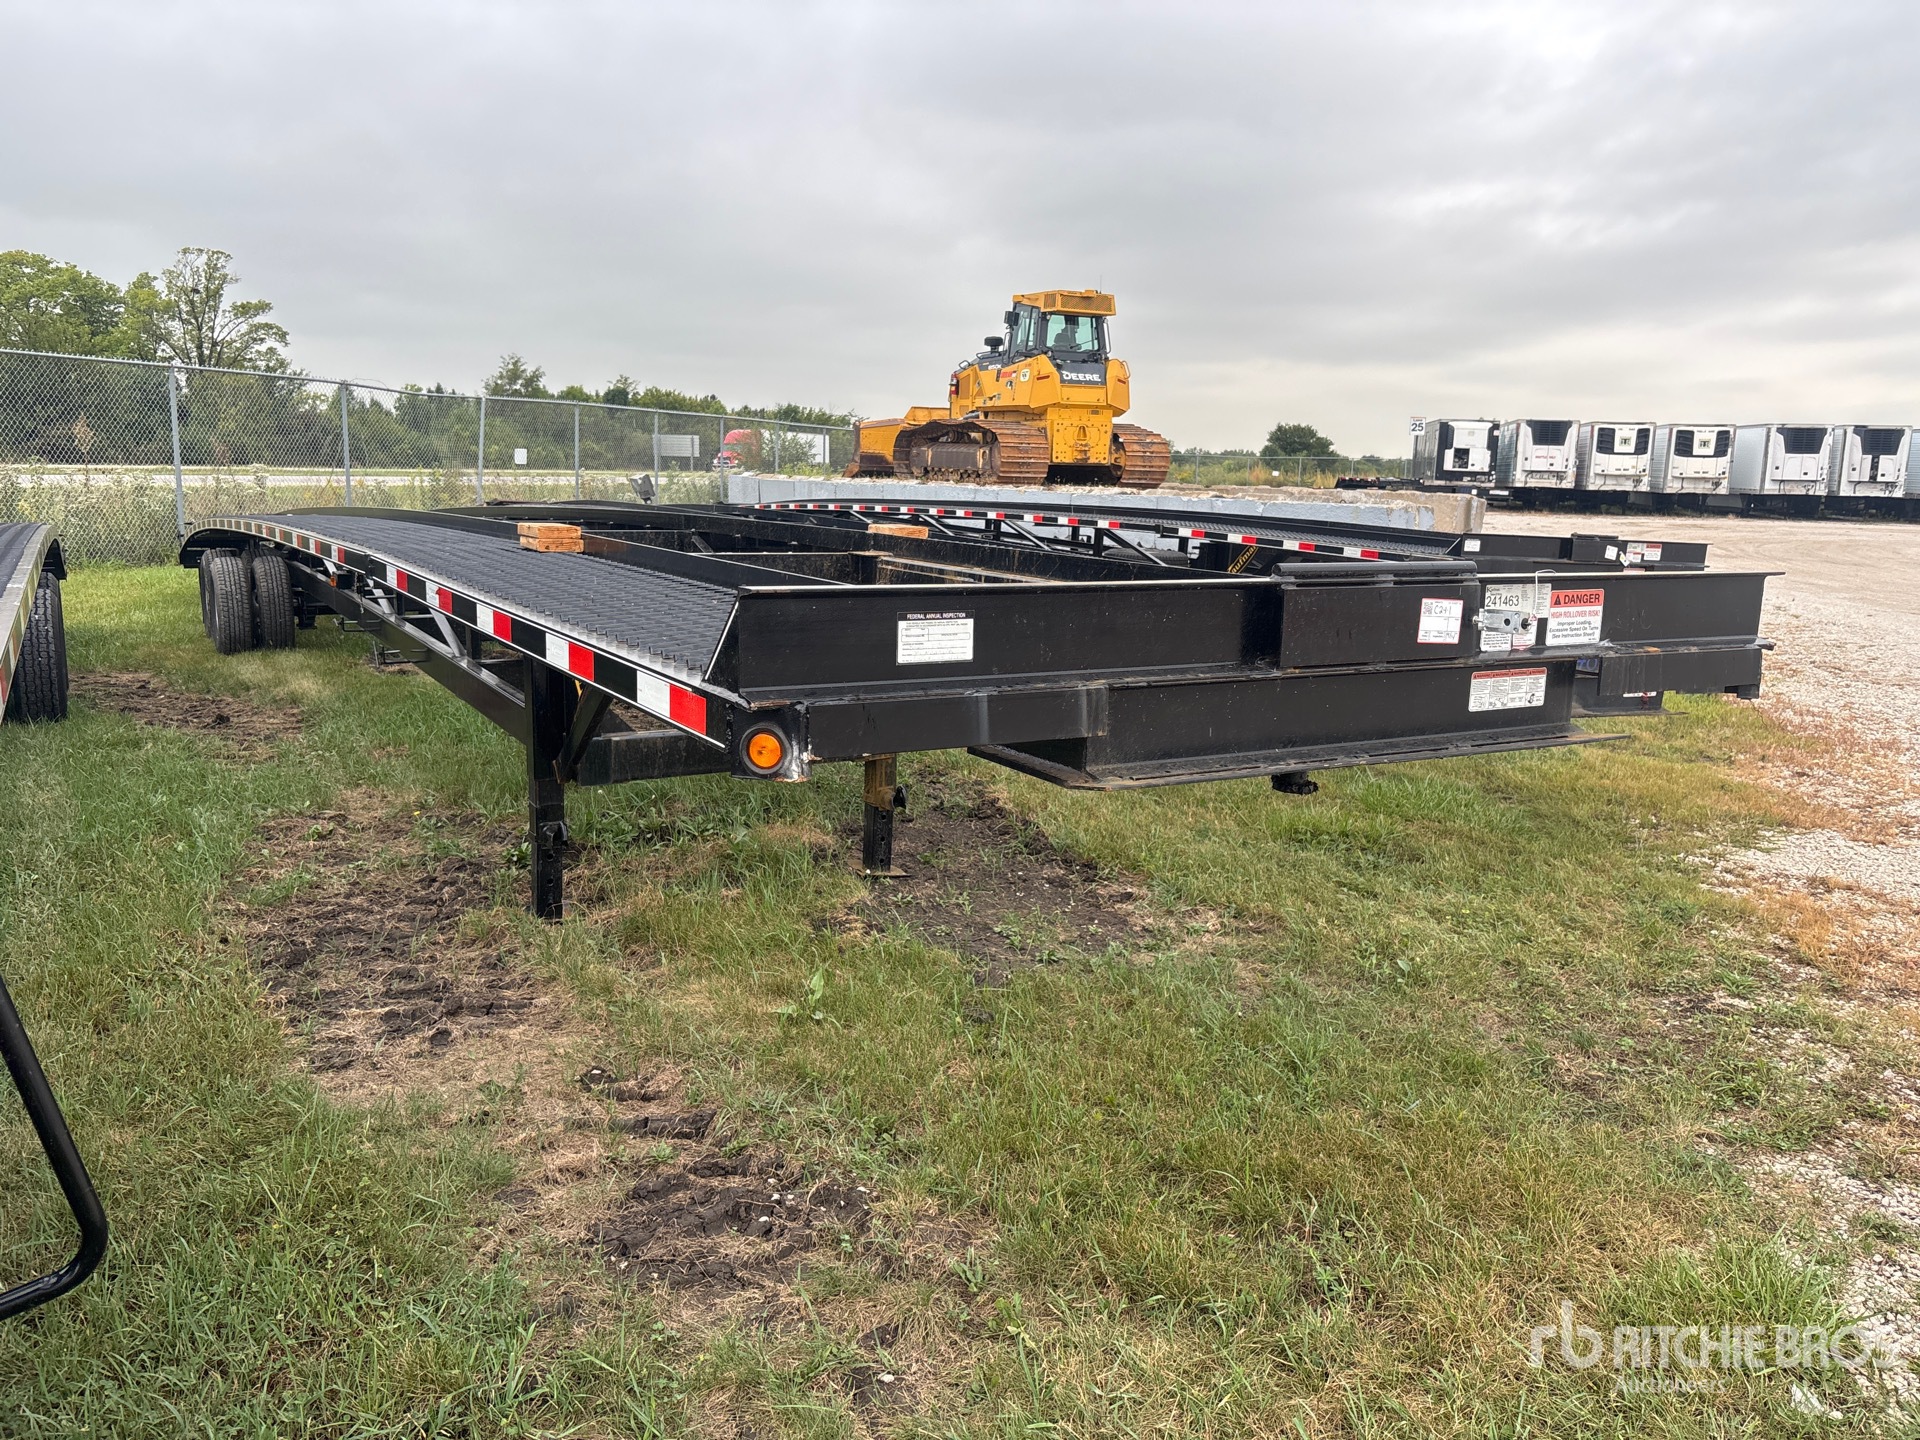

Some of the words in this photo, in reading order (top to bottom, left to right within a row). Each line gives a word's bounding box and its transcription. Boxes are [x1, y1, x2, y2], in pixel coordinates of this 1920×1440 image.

[1061, 370, 1102, 381] DEERE
[1411, 422, 1424, 432] 25
[1485, 594, 1520, 608] 241463
[1563, 593, 1601, 605] DANGER
[1551, 611, 1563, 619] HIGH
[1563, 610, 1587, 618] ROLLOVER
